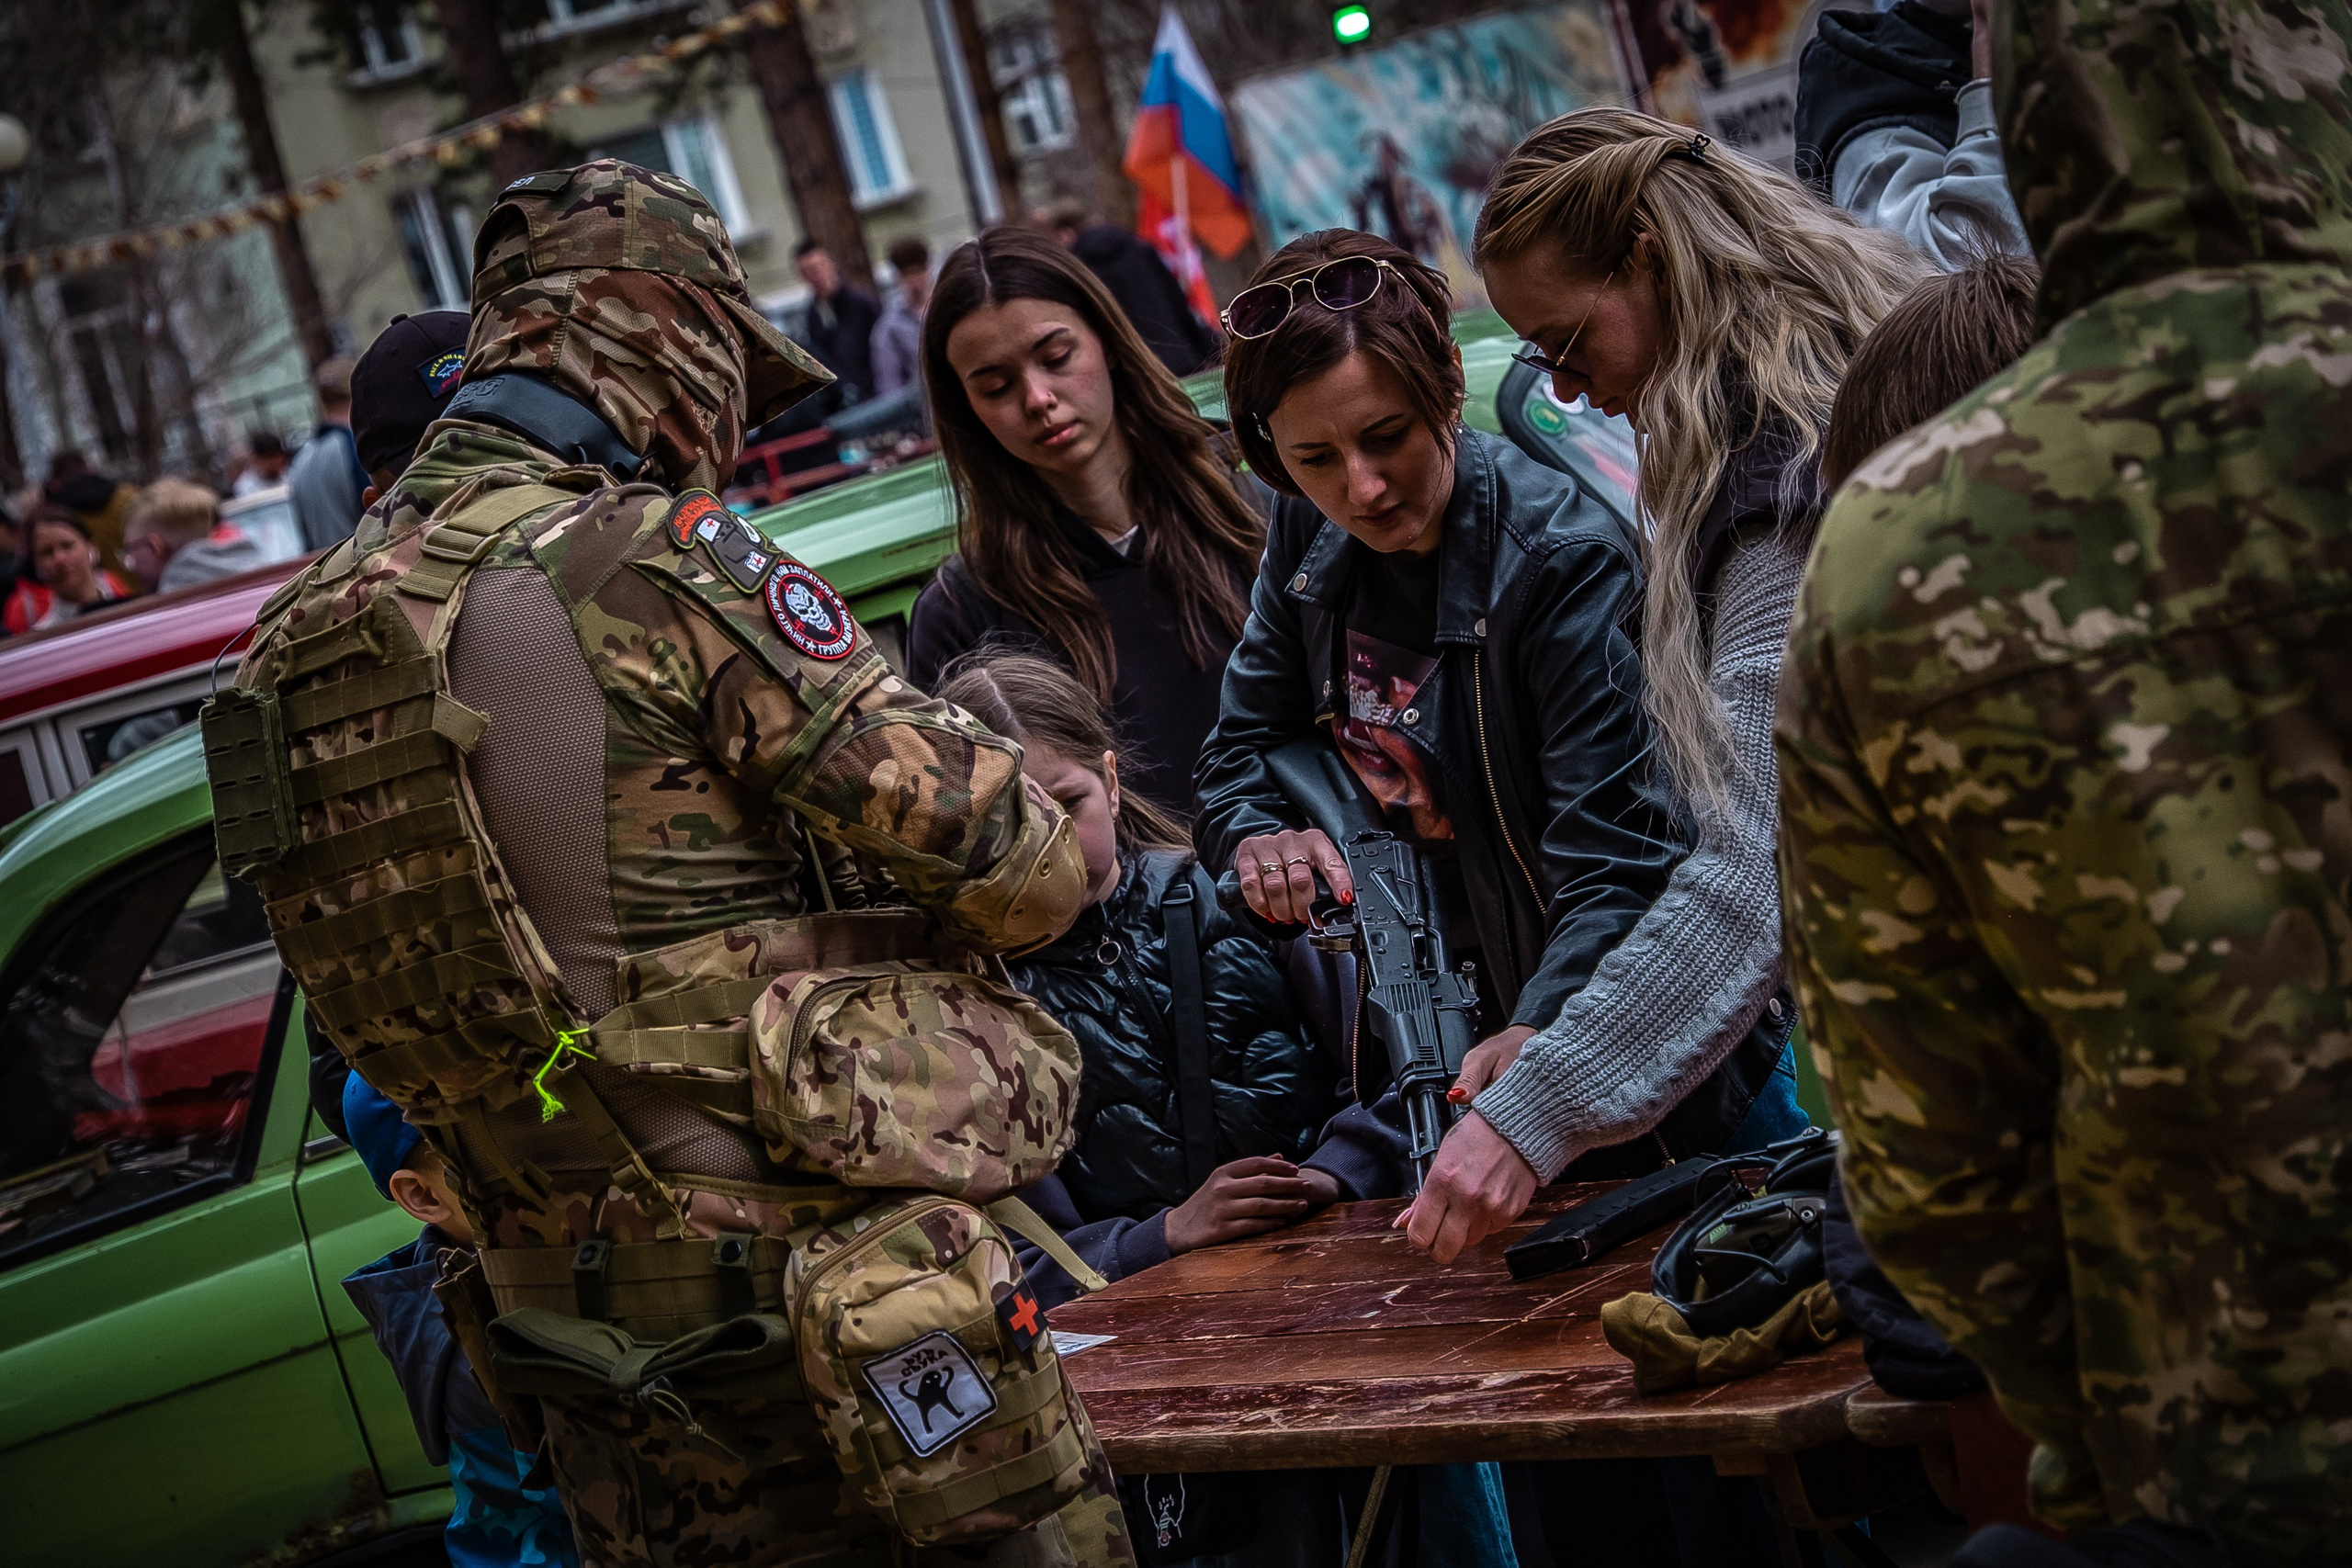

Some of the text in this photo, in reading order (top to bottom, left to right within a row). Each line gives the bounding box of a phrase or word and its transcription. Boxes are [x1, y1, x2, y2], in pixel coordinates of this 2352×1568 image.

[775, 565, 789, 579] НАМ
[788, 565, 833, 597] ЗАПЛАТИЛИ
[777, 613, 806, 645] НИЧЕГО
[818, 642, 848, 655] ГРУППА
